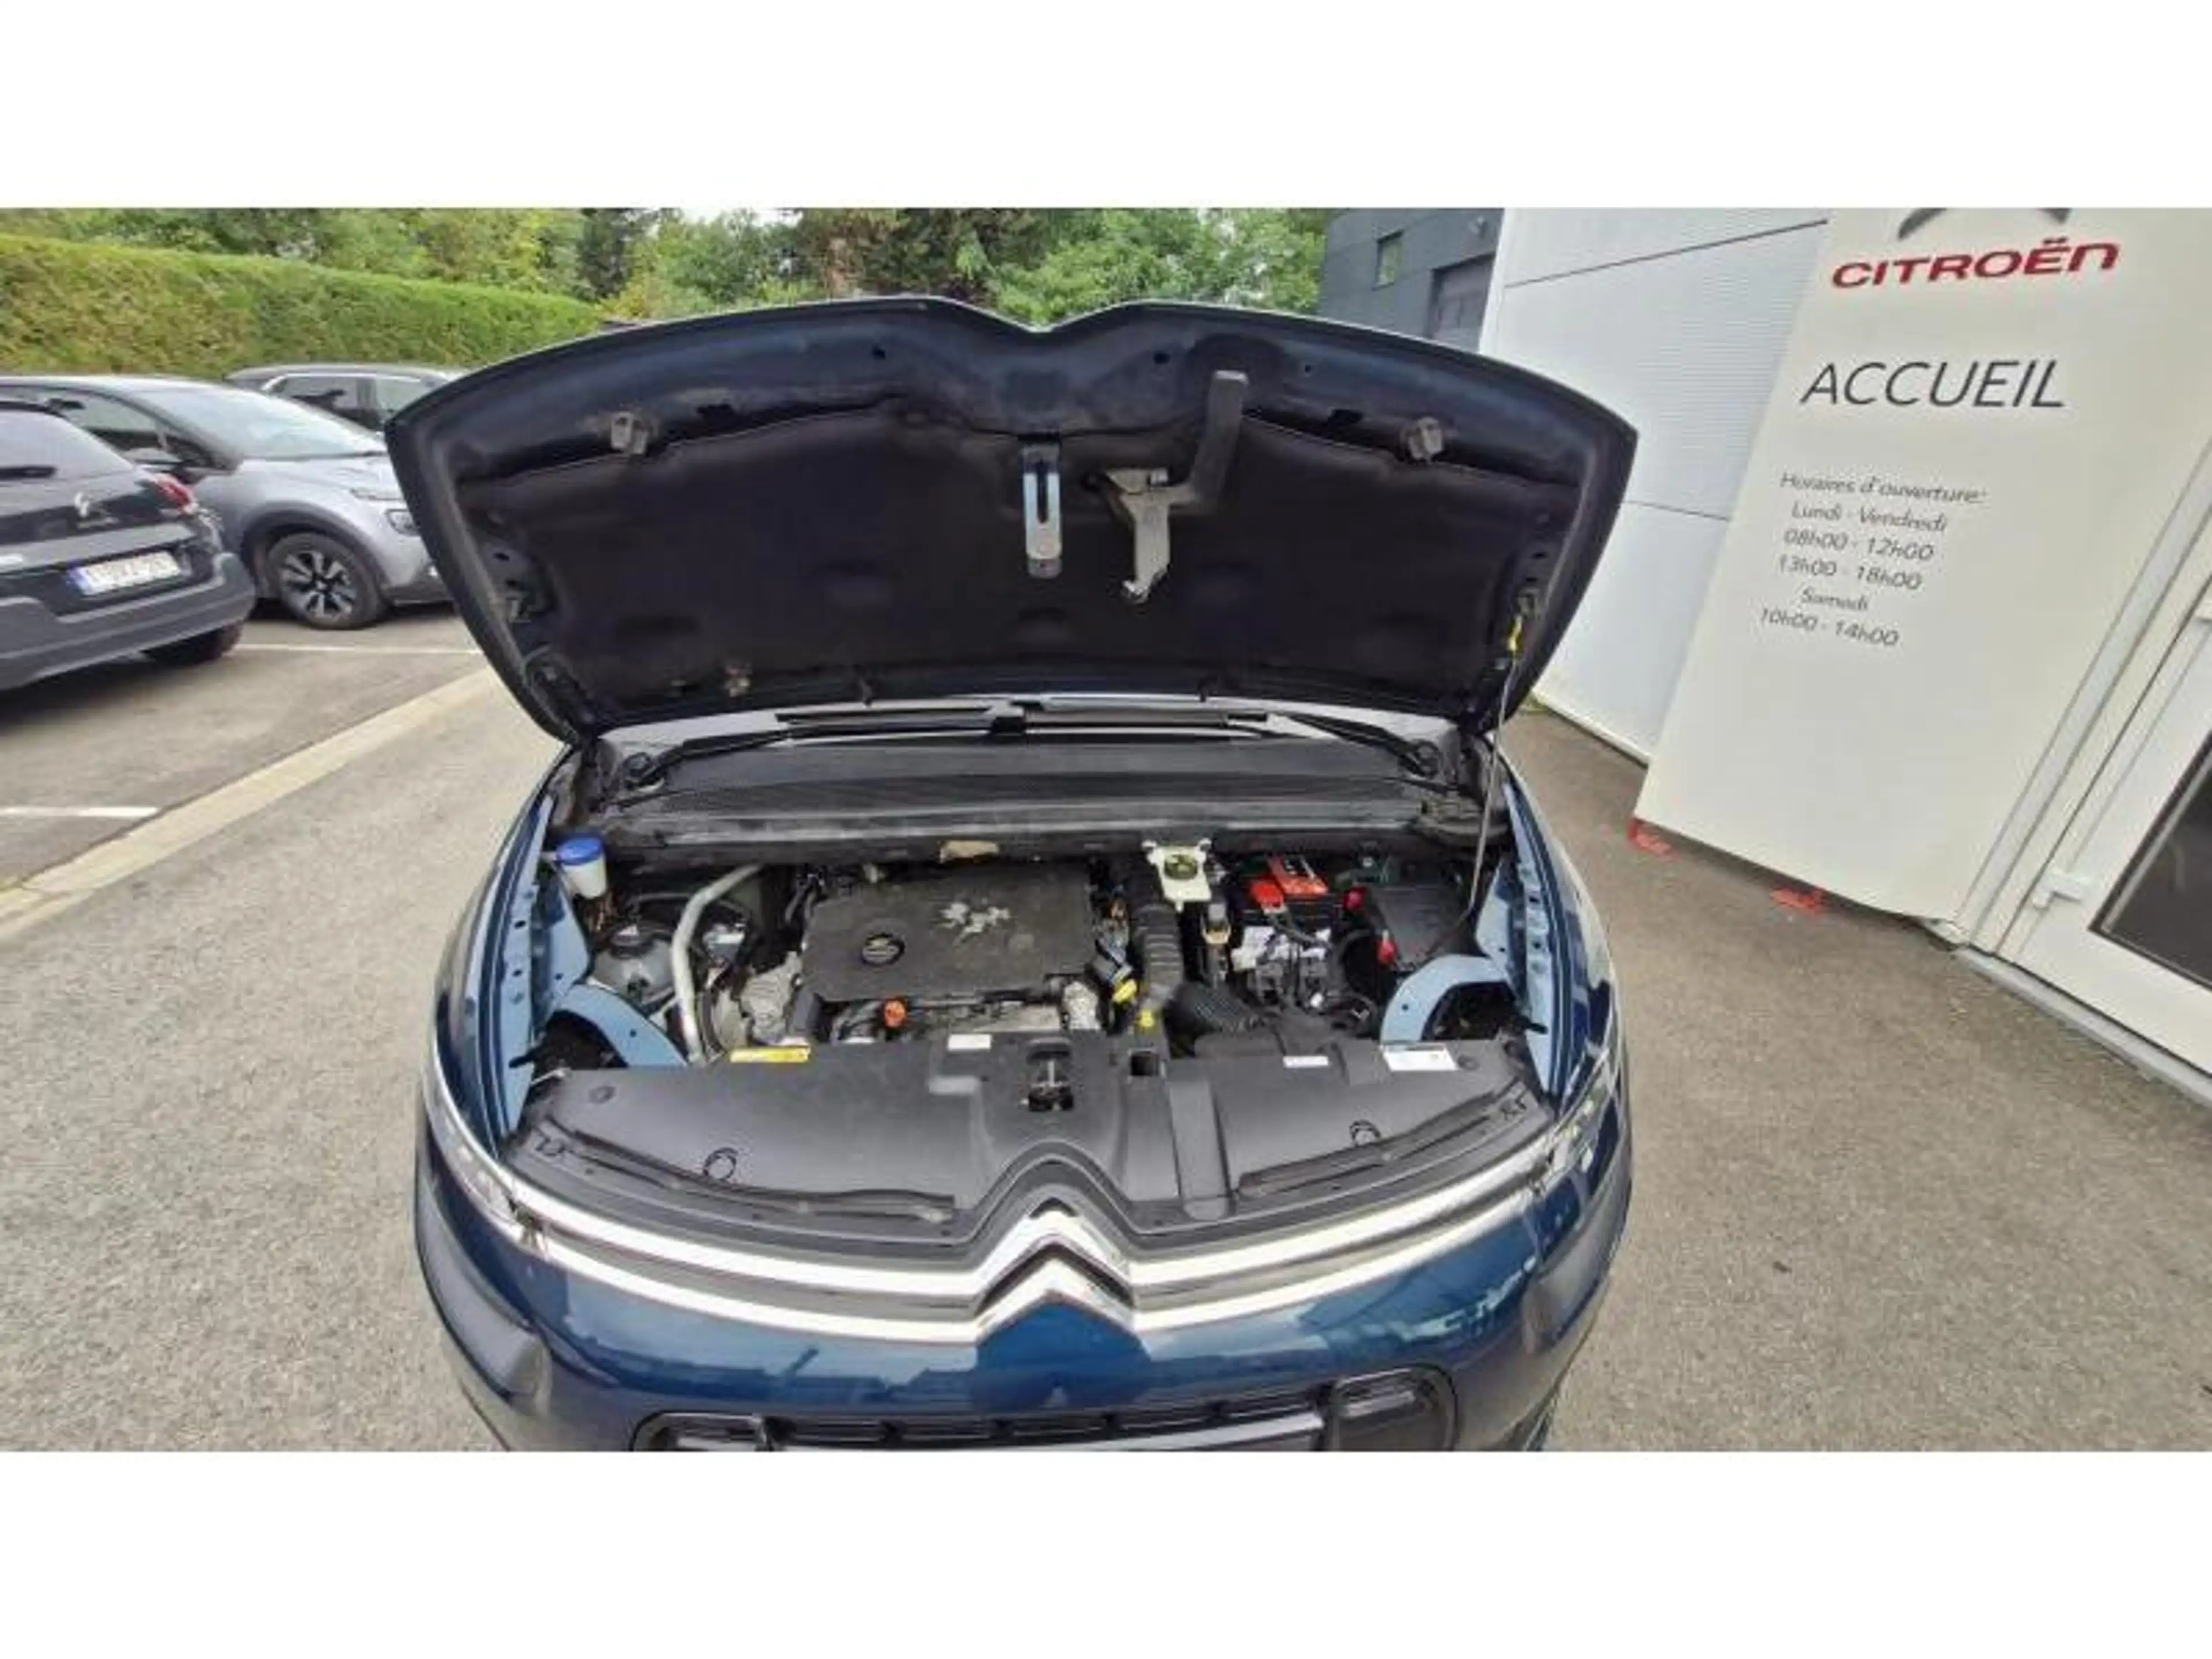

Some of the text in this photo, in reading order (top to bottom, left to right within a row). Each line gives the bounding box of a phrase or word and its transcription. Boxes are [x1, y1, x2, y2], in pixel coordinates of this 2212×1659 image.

[1800, 359, 2066, 408] ACCUEIL
[1784, 528, 1849, 550] 08h00
[1868, 537, 1934, 561] 12h00
[1779, 553, 1838, 577] 13h00
[1857, 565, 1922, 590] 18h00
[1761, 607, 1819, 631] 10h00
[1835, 619, 1900, 646] 14h00
